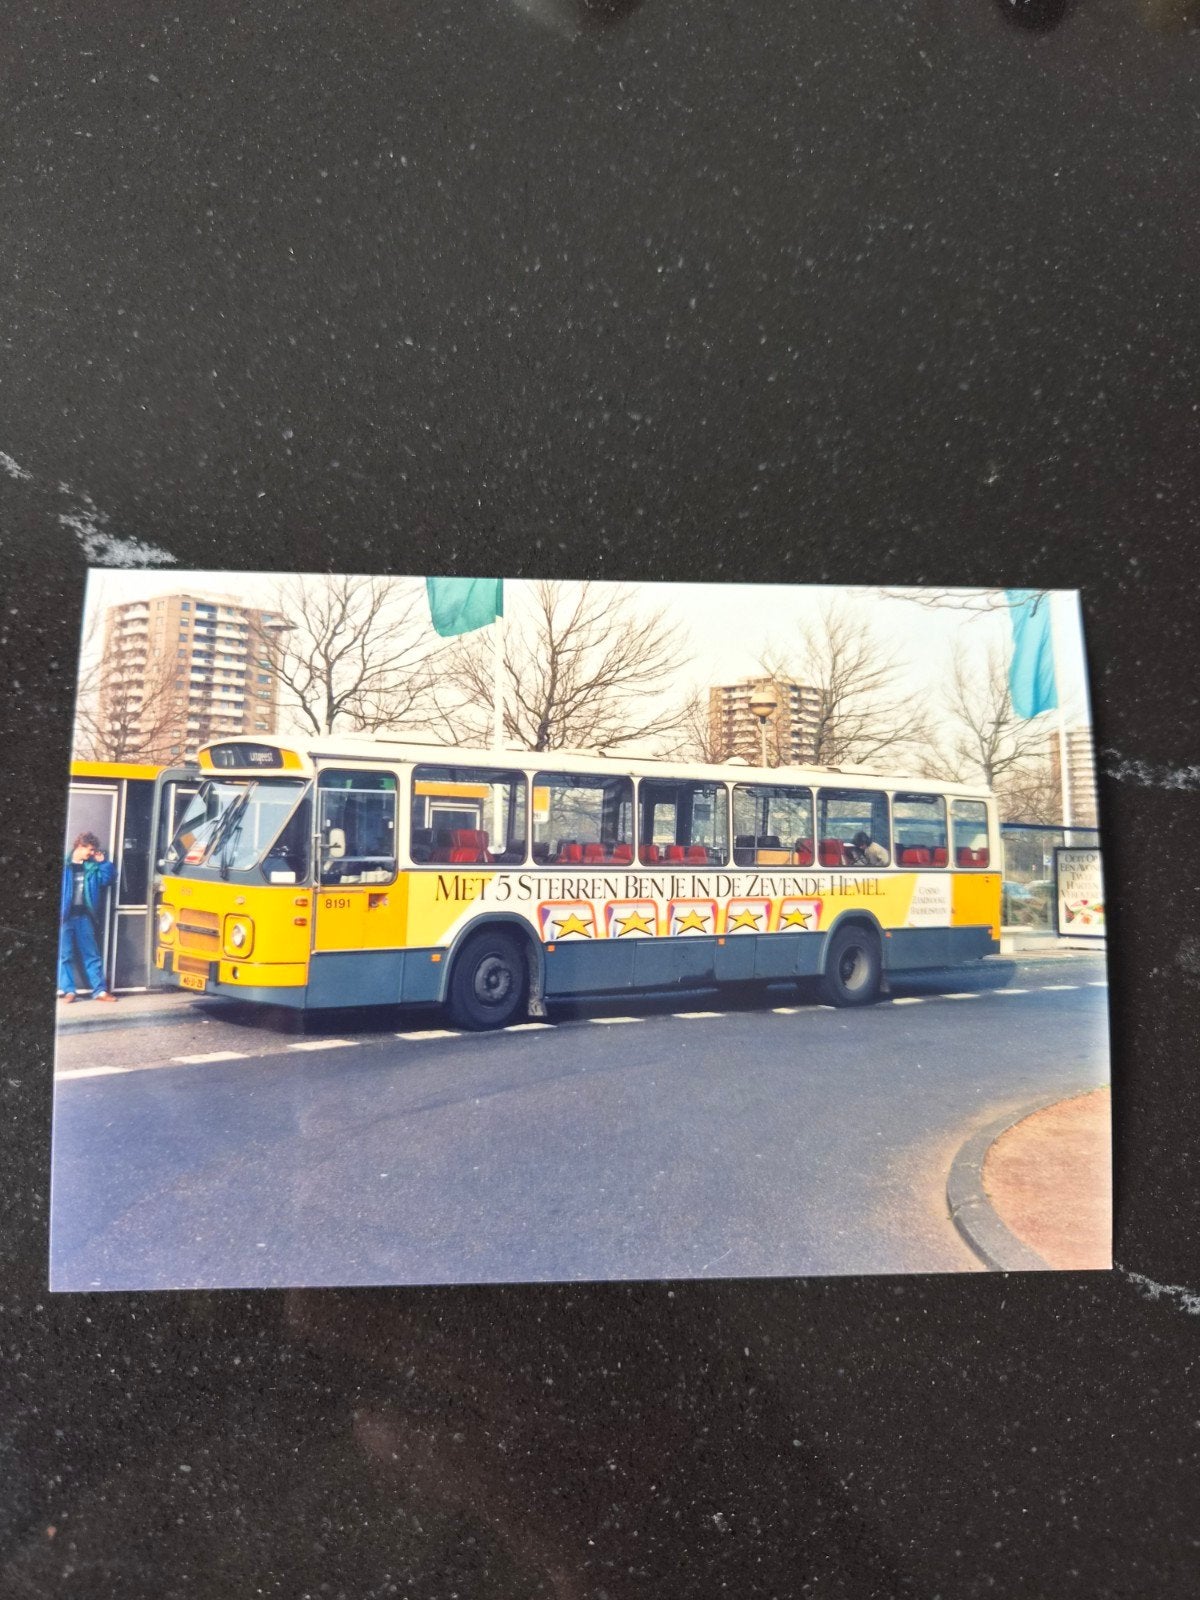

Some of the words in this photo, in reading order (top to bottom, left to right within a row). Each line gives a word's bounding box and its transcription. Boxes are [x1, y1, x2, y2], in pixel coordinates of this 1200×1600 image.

[435, 874, 493, 901] MET
[495, 874, 512, 901] 5
[517, 874, 619, 900] STERREN
[625, 874, 665, 899] BEN
[666, 874, 687, 901] JE
[691, 874, 710, 898] IN
[716, 874, 742, 898] DE
[746, 874, 826, 897] ZEVENDE
[830, 874, 886, 896] HEMEL.
[325, 898, 351, 909] 8191
